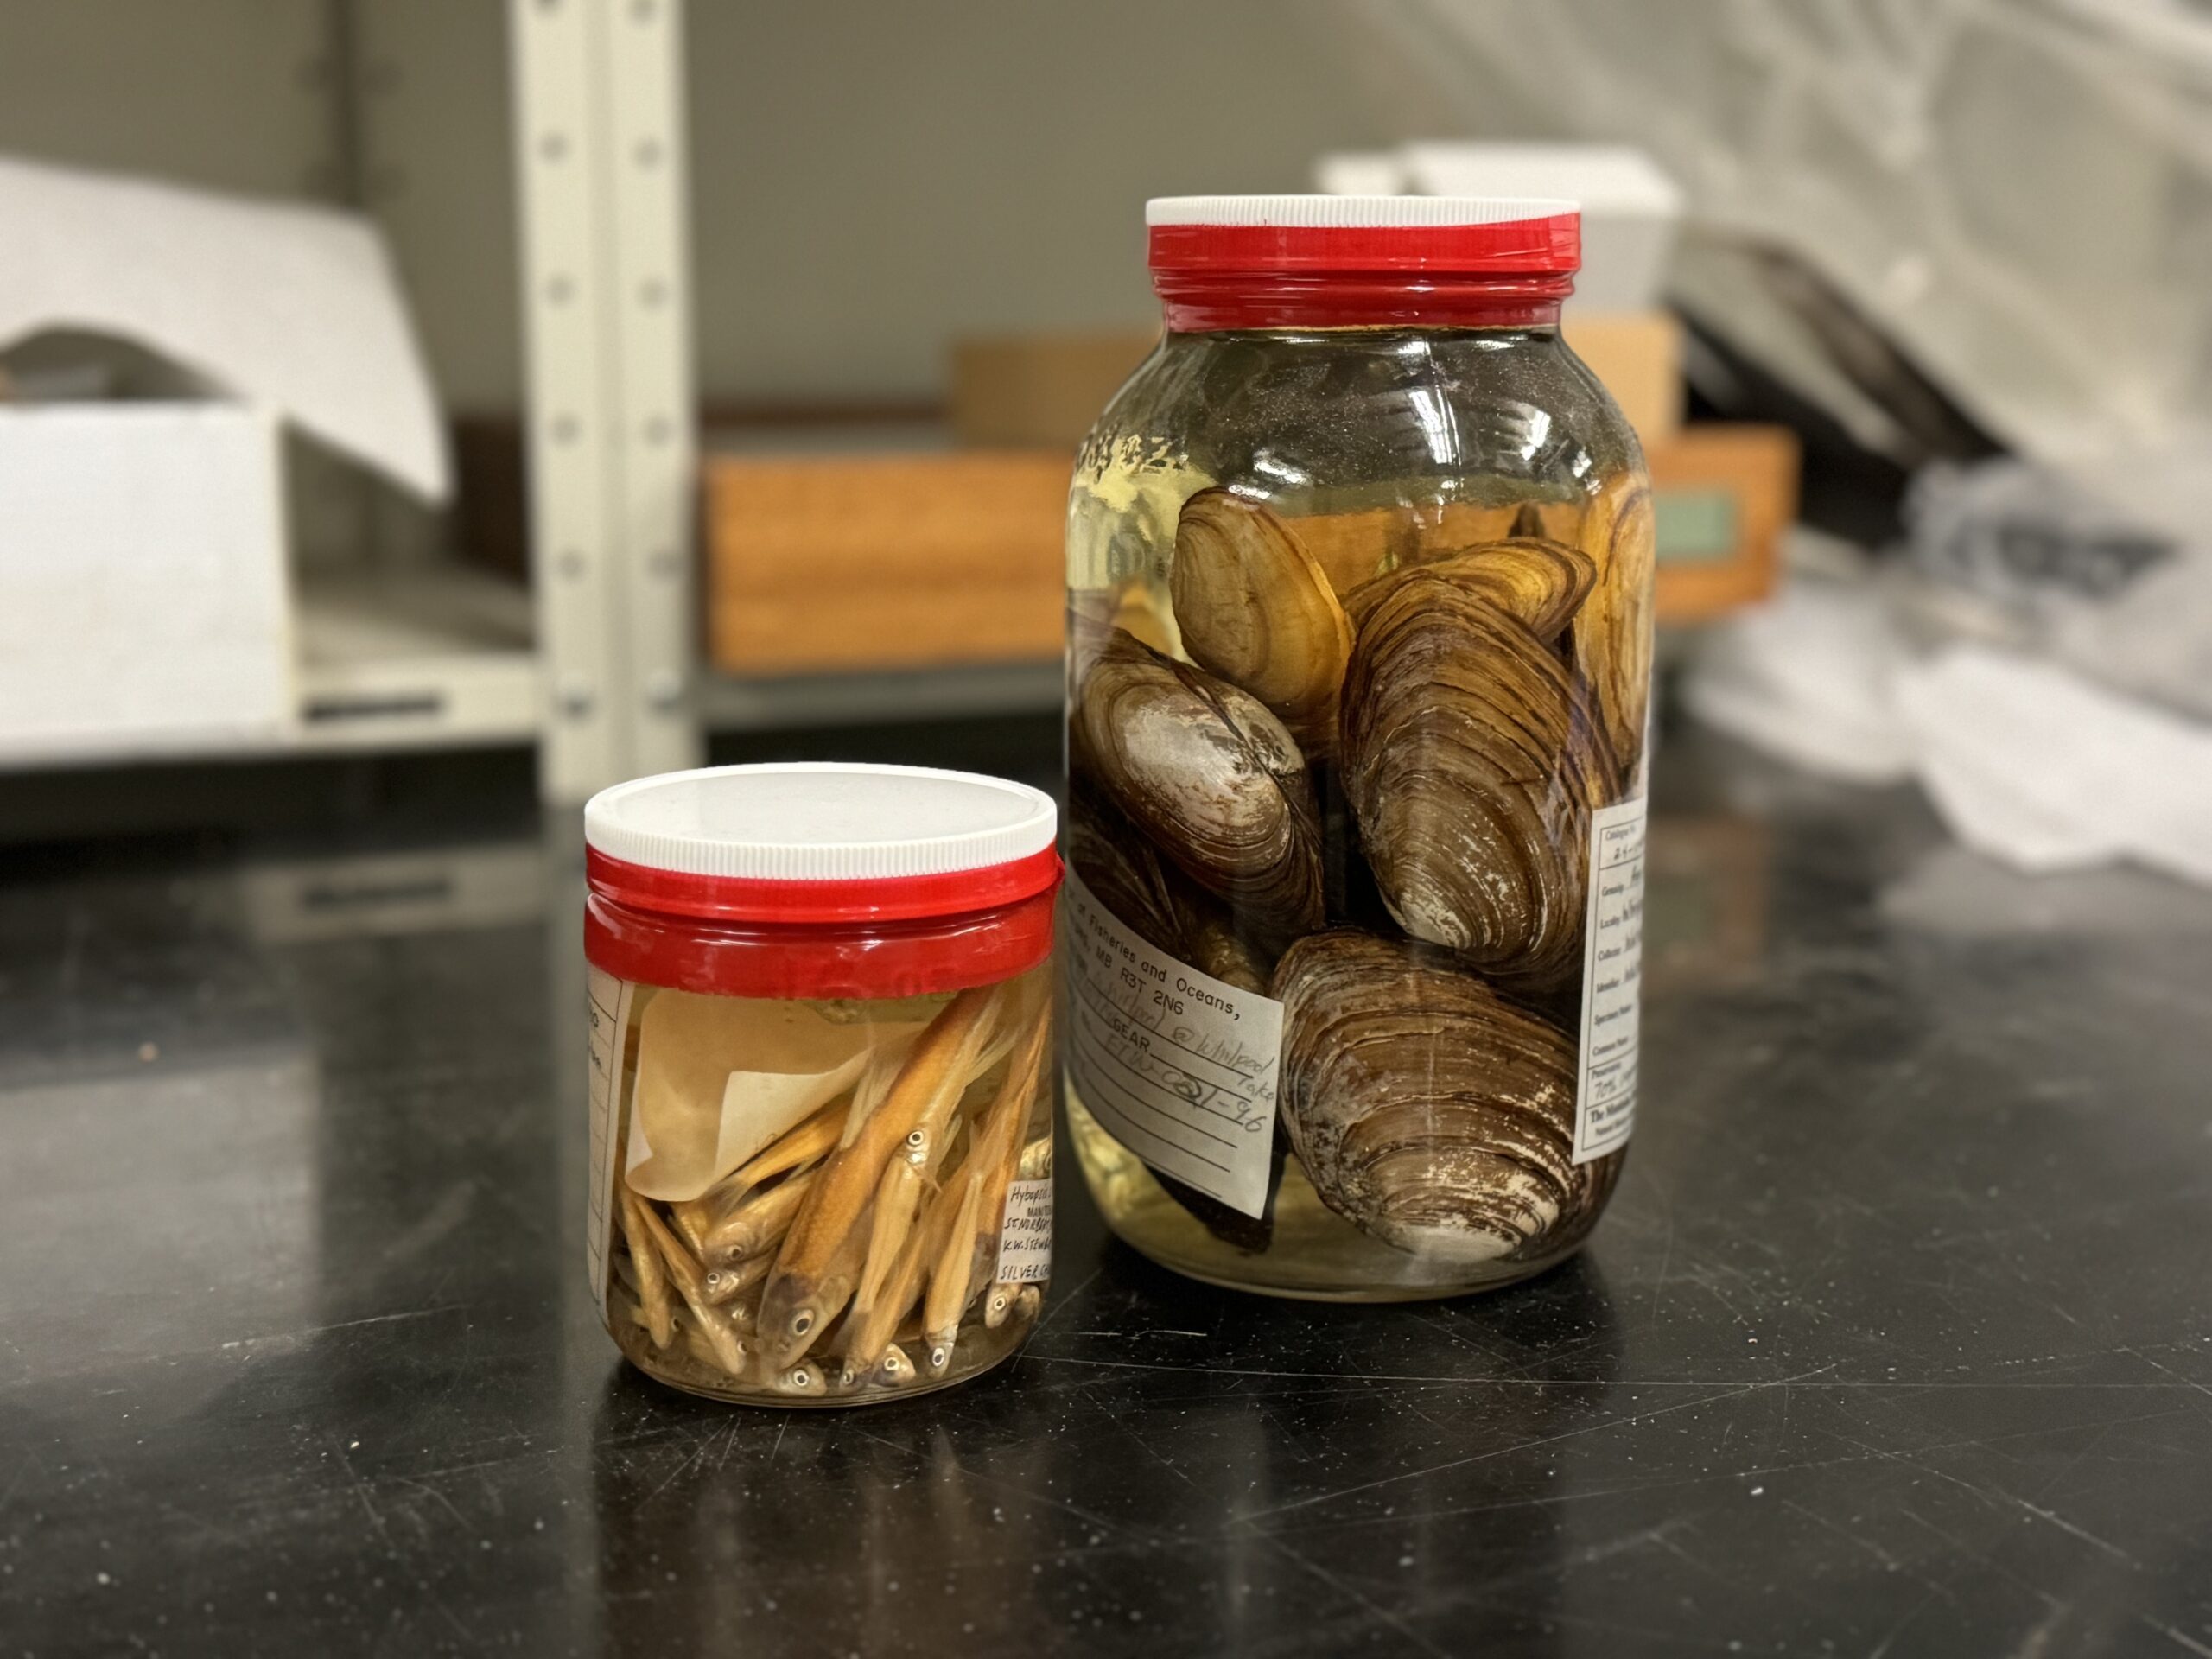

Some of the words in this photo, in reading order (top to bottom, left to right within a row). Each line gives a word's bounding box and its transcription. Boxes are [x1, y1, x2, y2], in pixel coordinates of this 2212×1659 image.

[1089, 913, 1137, 963] Fisheries
[1141, 961, 1167, 983] and
[1176, 977, 1241, 1021] Oceans,
[1120, 967, 1147, 994] R3T
[1153, 989, 1185, 1015] 2N6
[1111, 1018, 1151, 1052] GEAR
